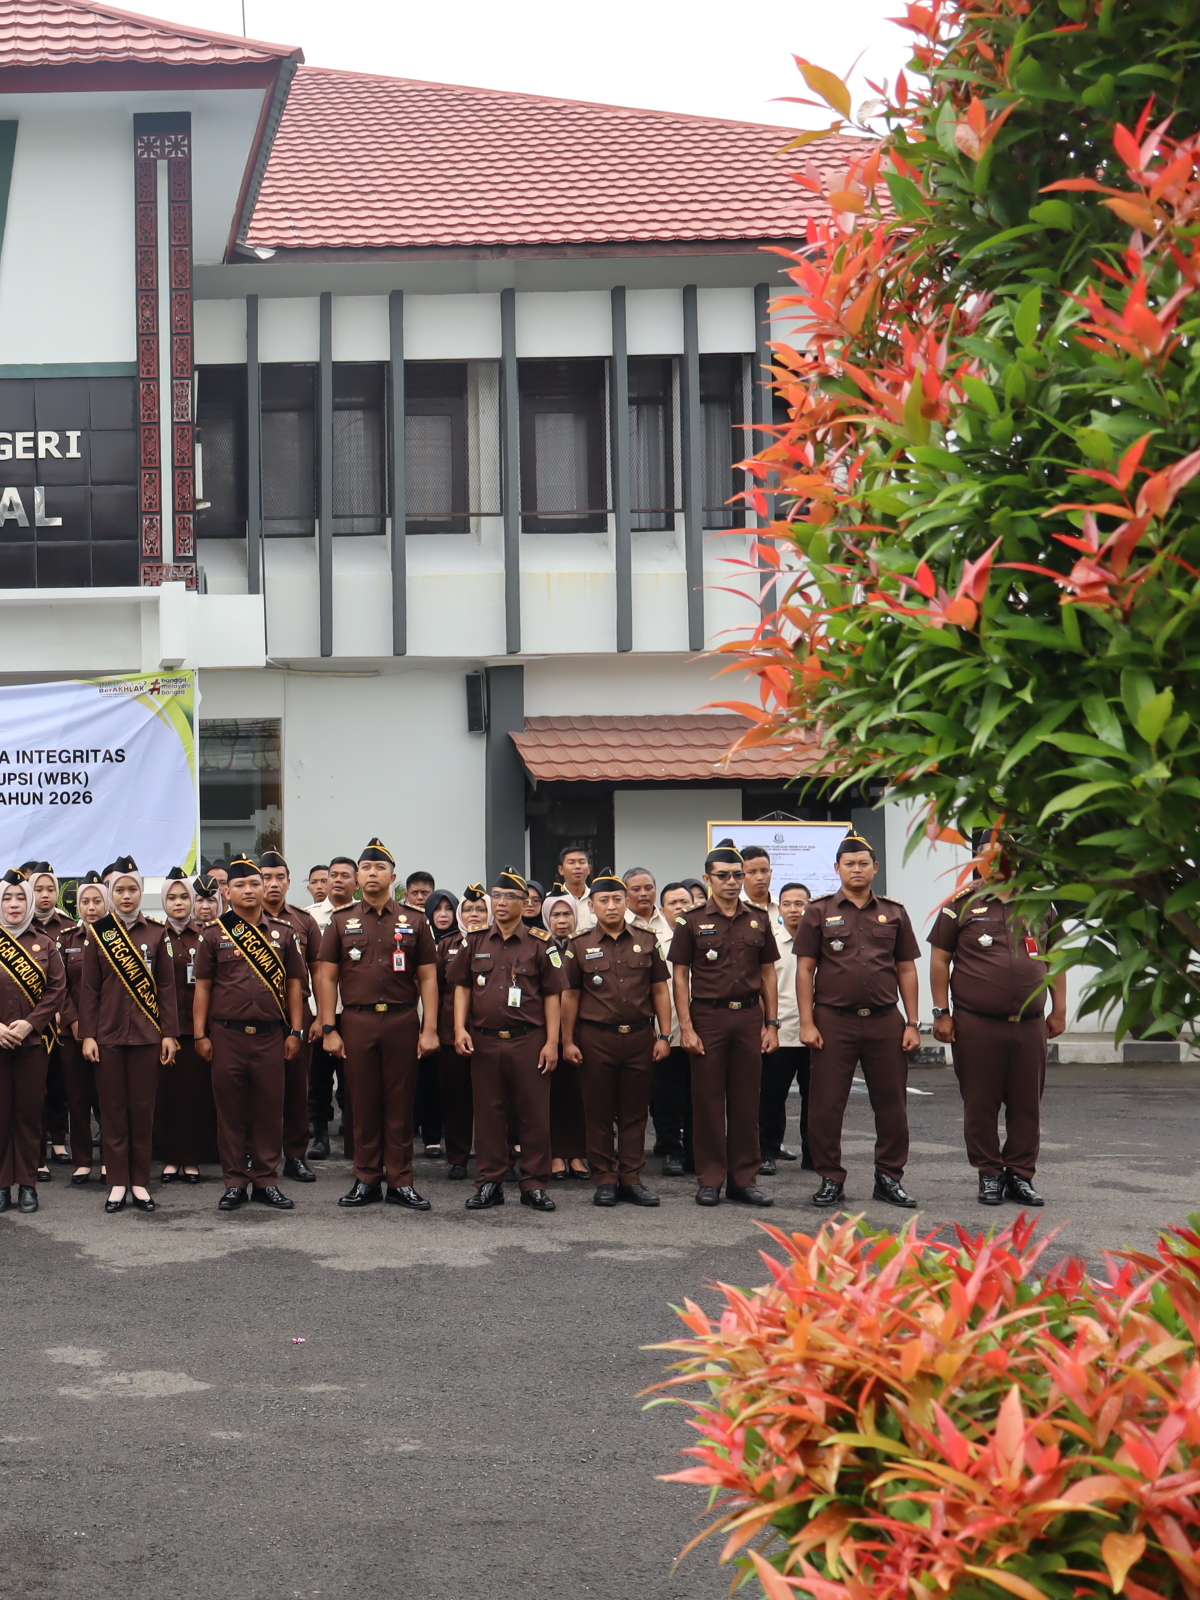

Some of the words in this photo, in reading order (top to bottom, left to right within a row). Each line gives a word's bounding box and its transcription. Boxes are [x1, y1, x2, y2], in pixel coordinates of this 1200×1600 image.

[16, 748, 126, 764] INTEGRITAS
[37, 771, 89, 788] (WBK)
[48, 790, 93, 805] 2026
[108, 937, 143, 981] PEGAWAI
[238, 930, 277, 973] PEGAWAI
